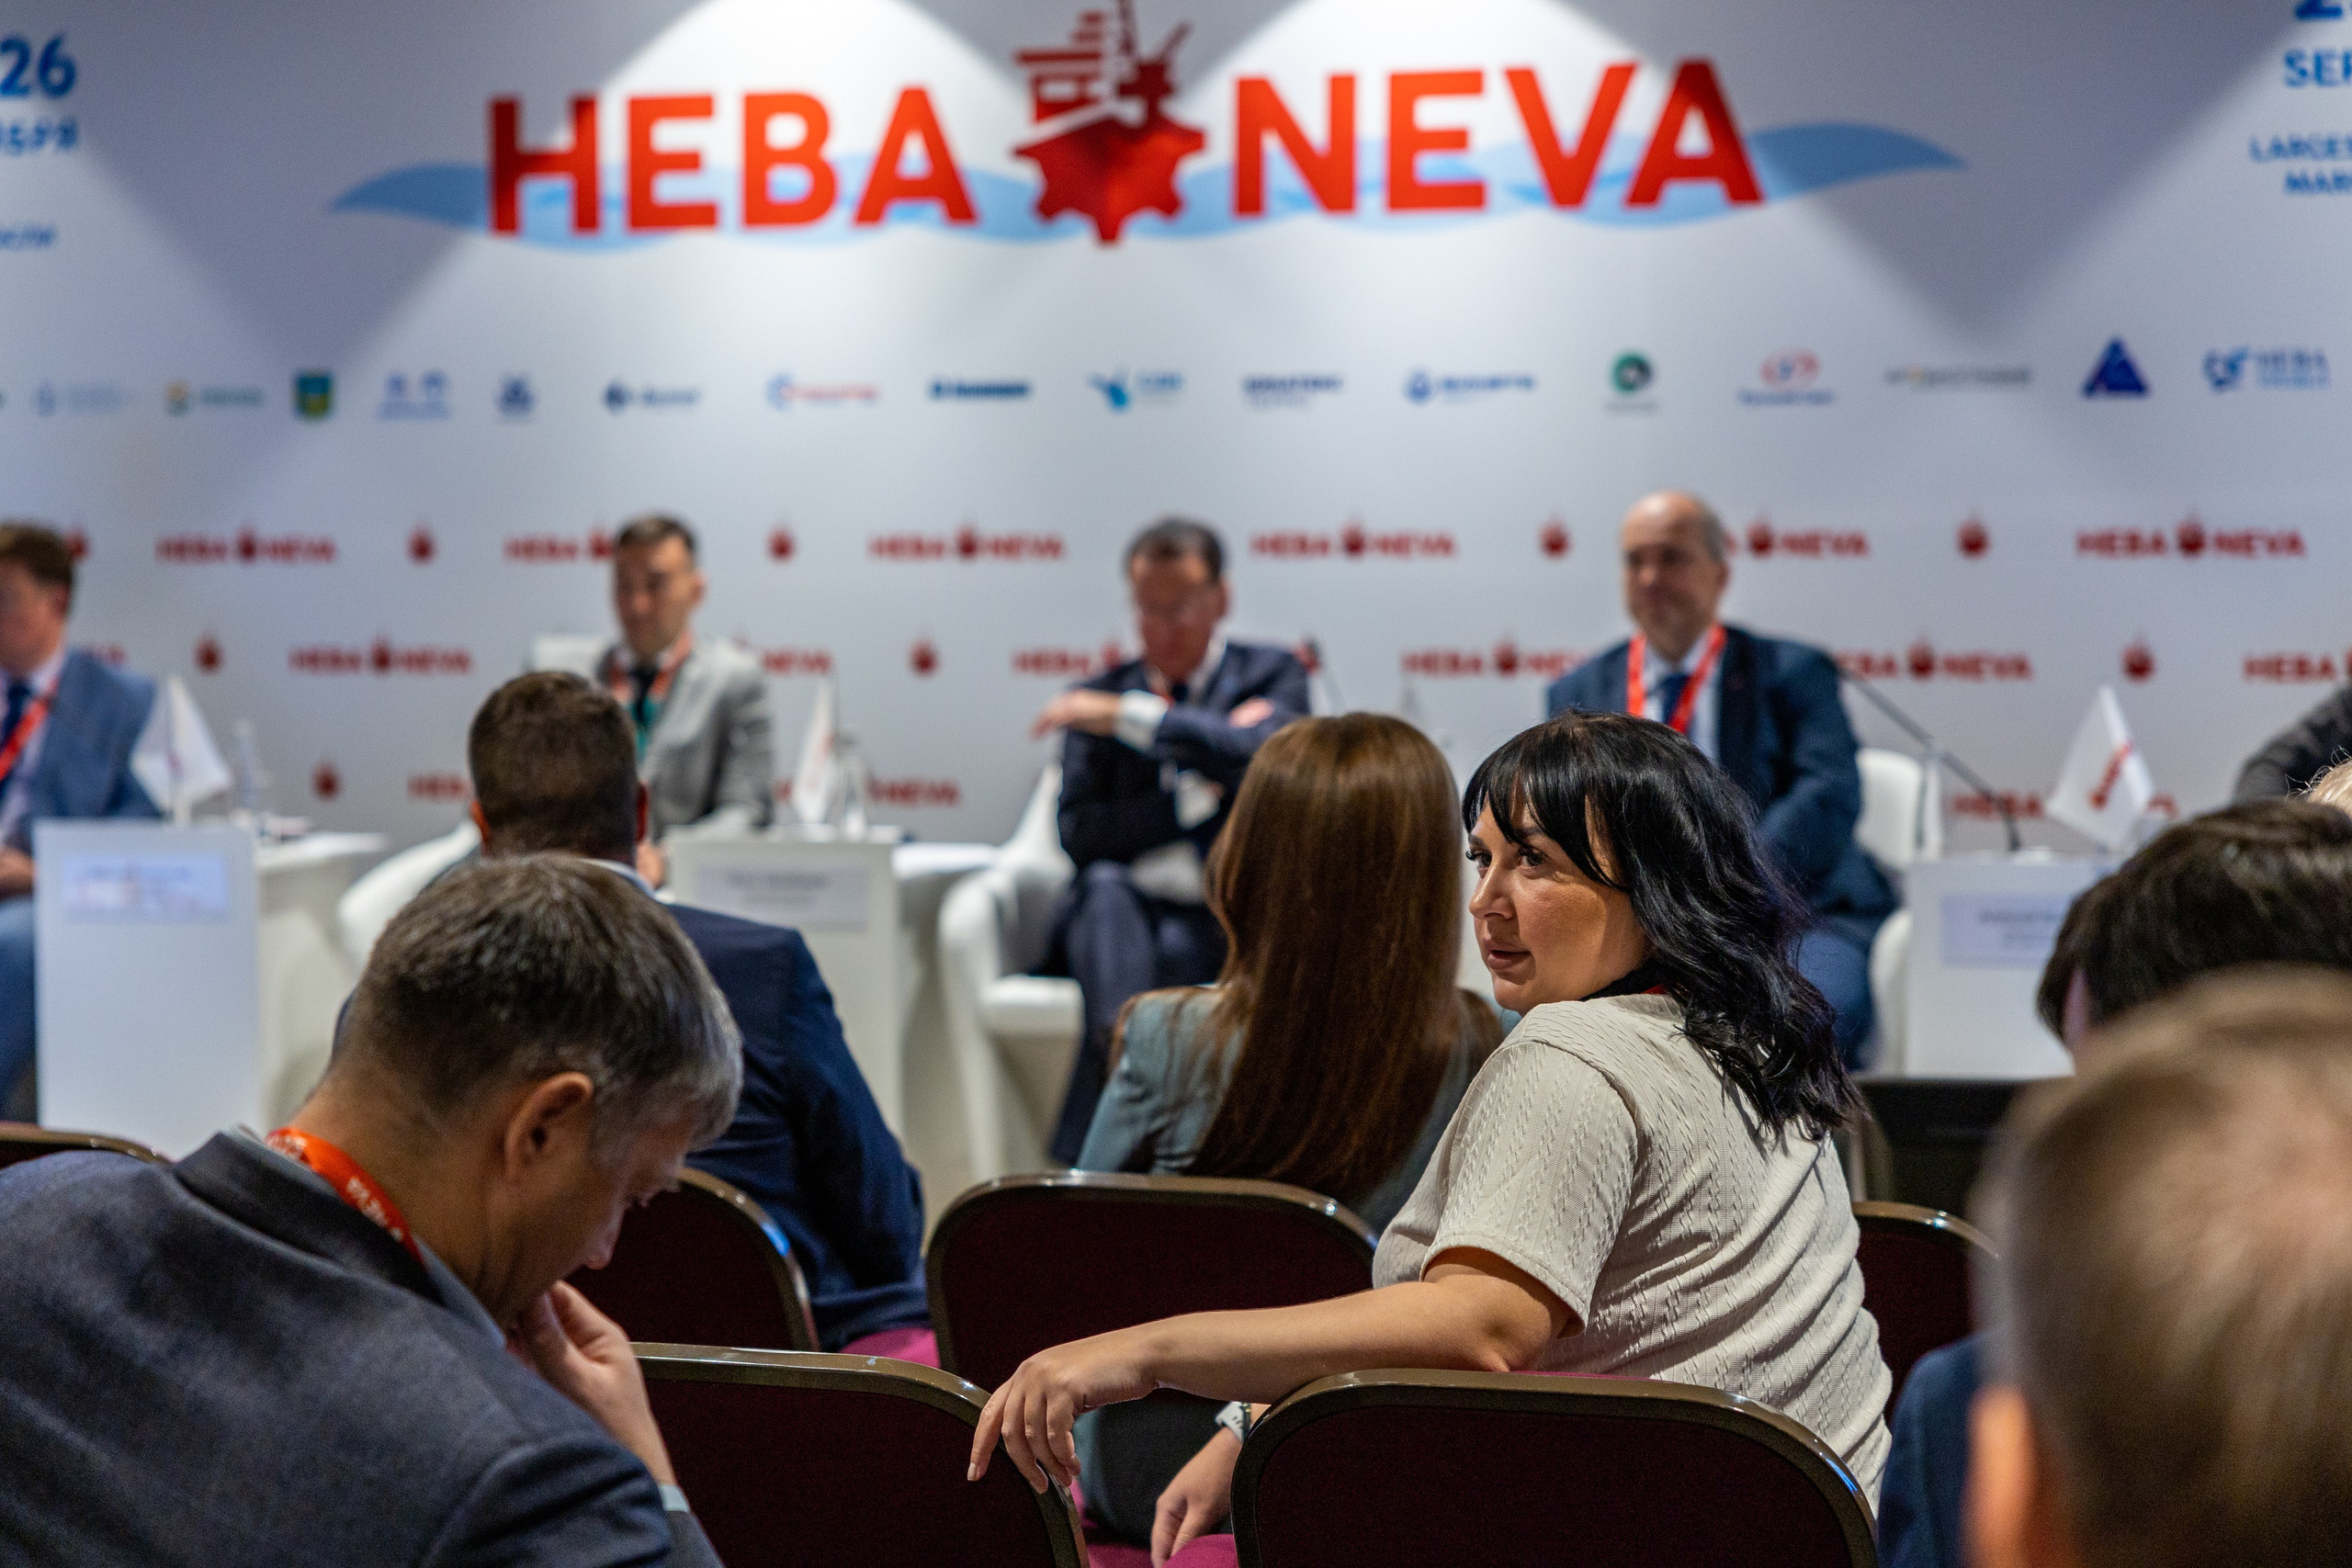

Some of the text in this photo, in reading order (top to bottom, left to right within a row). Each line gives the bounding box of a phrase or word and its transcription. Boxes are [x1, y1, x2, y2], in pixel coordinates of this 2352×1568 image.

[487, 57, 1764, 238] НЕВА NEVA
[1367, 531, 1455, 558] NEVA
[1779, 530, 1869, 558] NEVA
[2211, 529, 2306, 558] NEVA
[1940, 651, 2034, 682] NEVA
